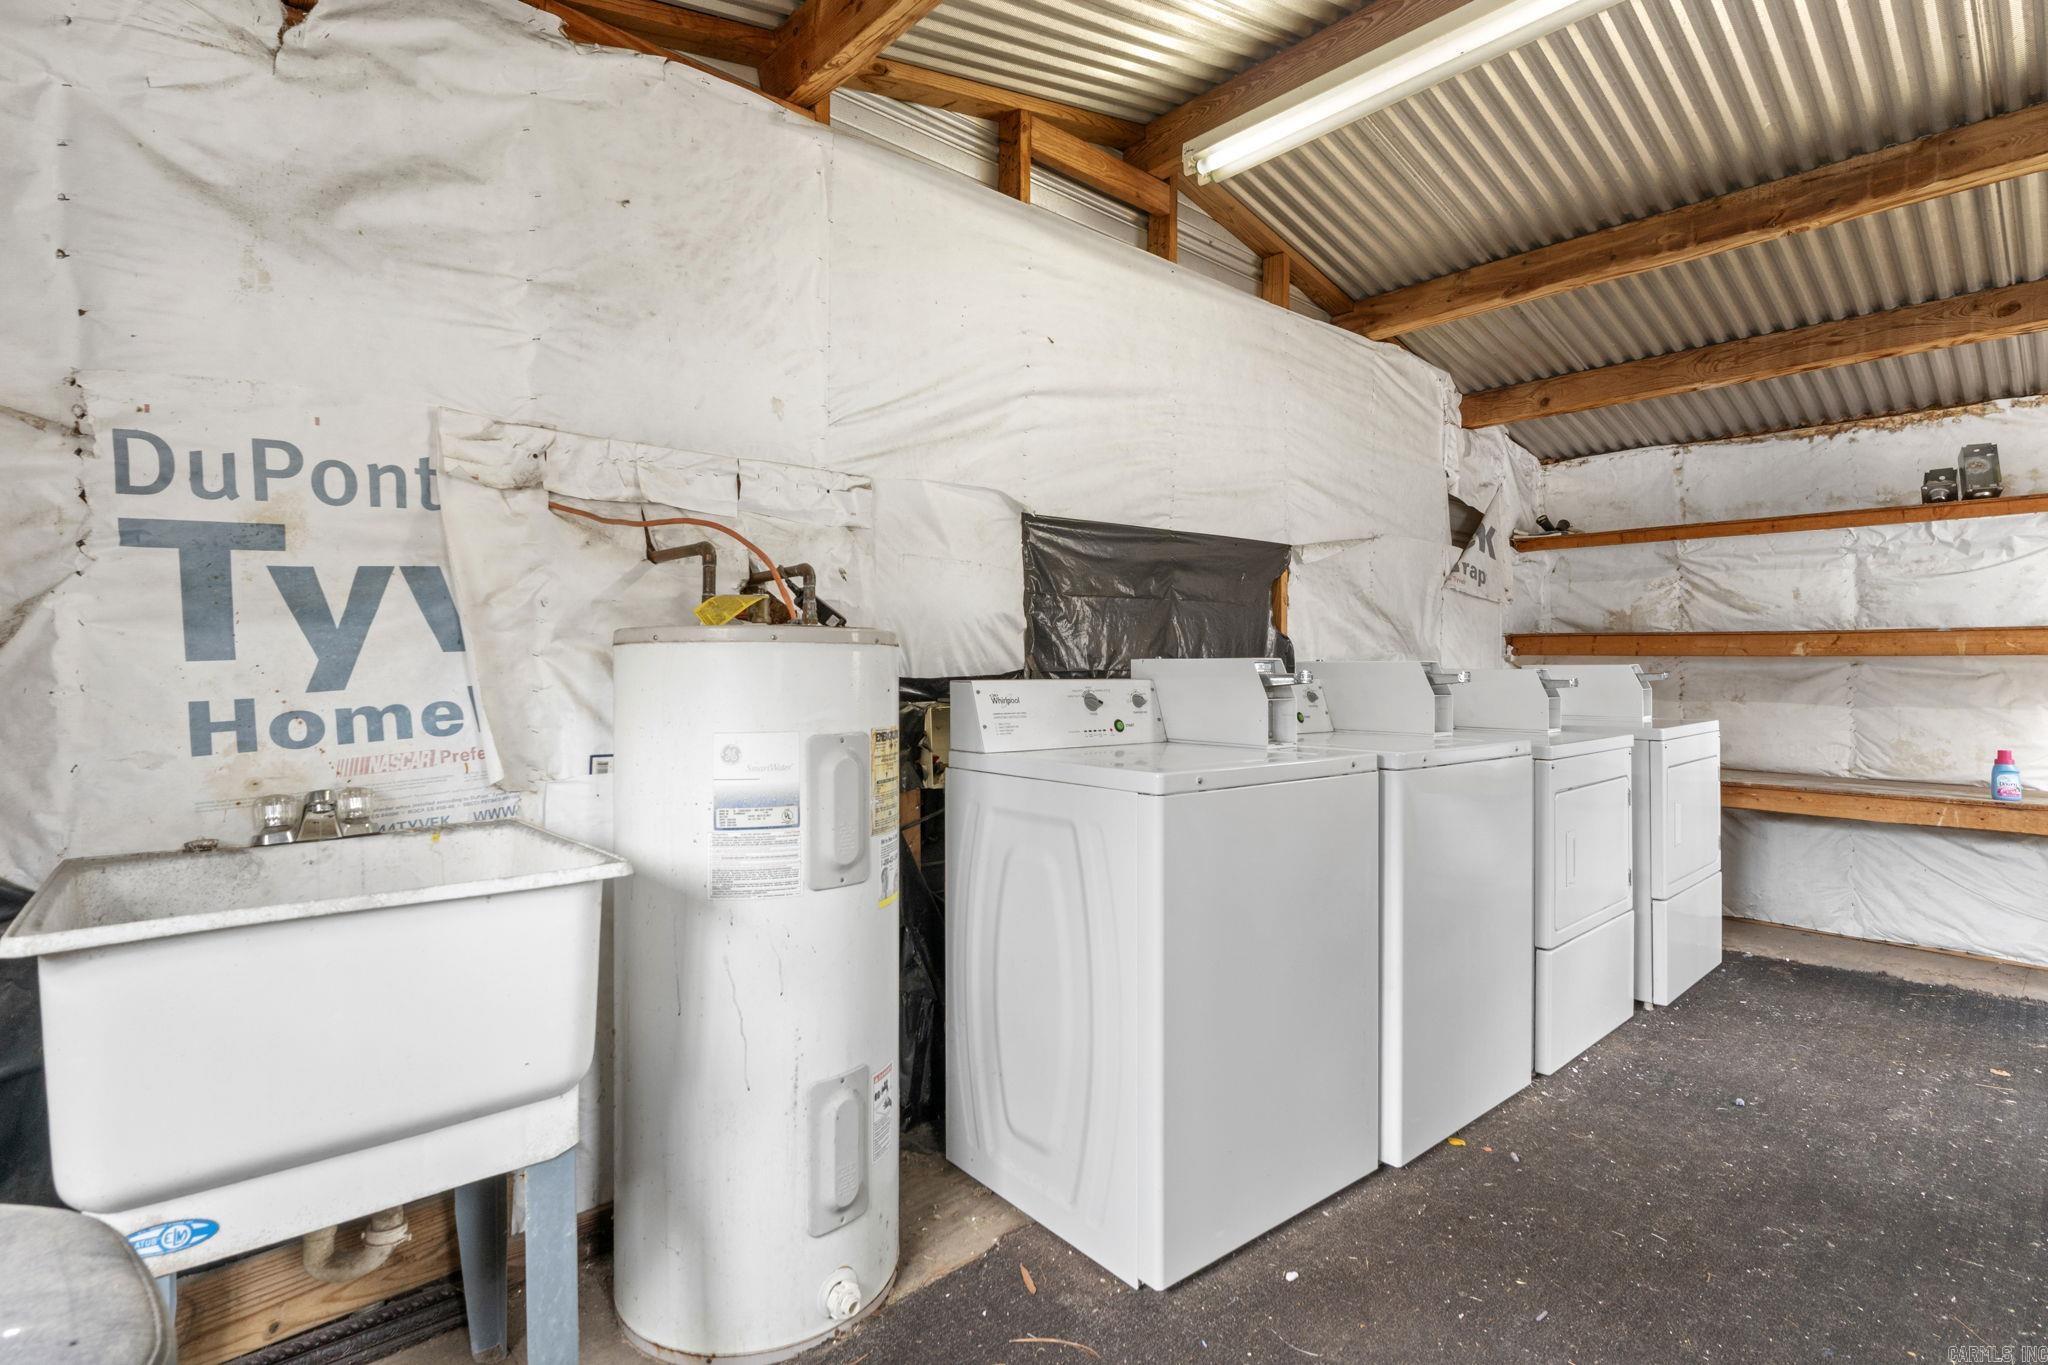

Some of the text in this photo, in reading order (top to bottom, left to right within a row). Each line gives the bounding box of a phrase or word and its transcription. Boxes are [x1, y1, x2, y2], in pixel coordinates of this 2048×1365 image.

[112, 427, 442, 514] DuPont
[188, 686, 482, 758] Home
[990, 696, 1020, 706] Whirlpool
[367, 749, 436, 774] NASCAR
